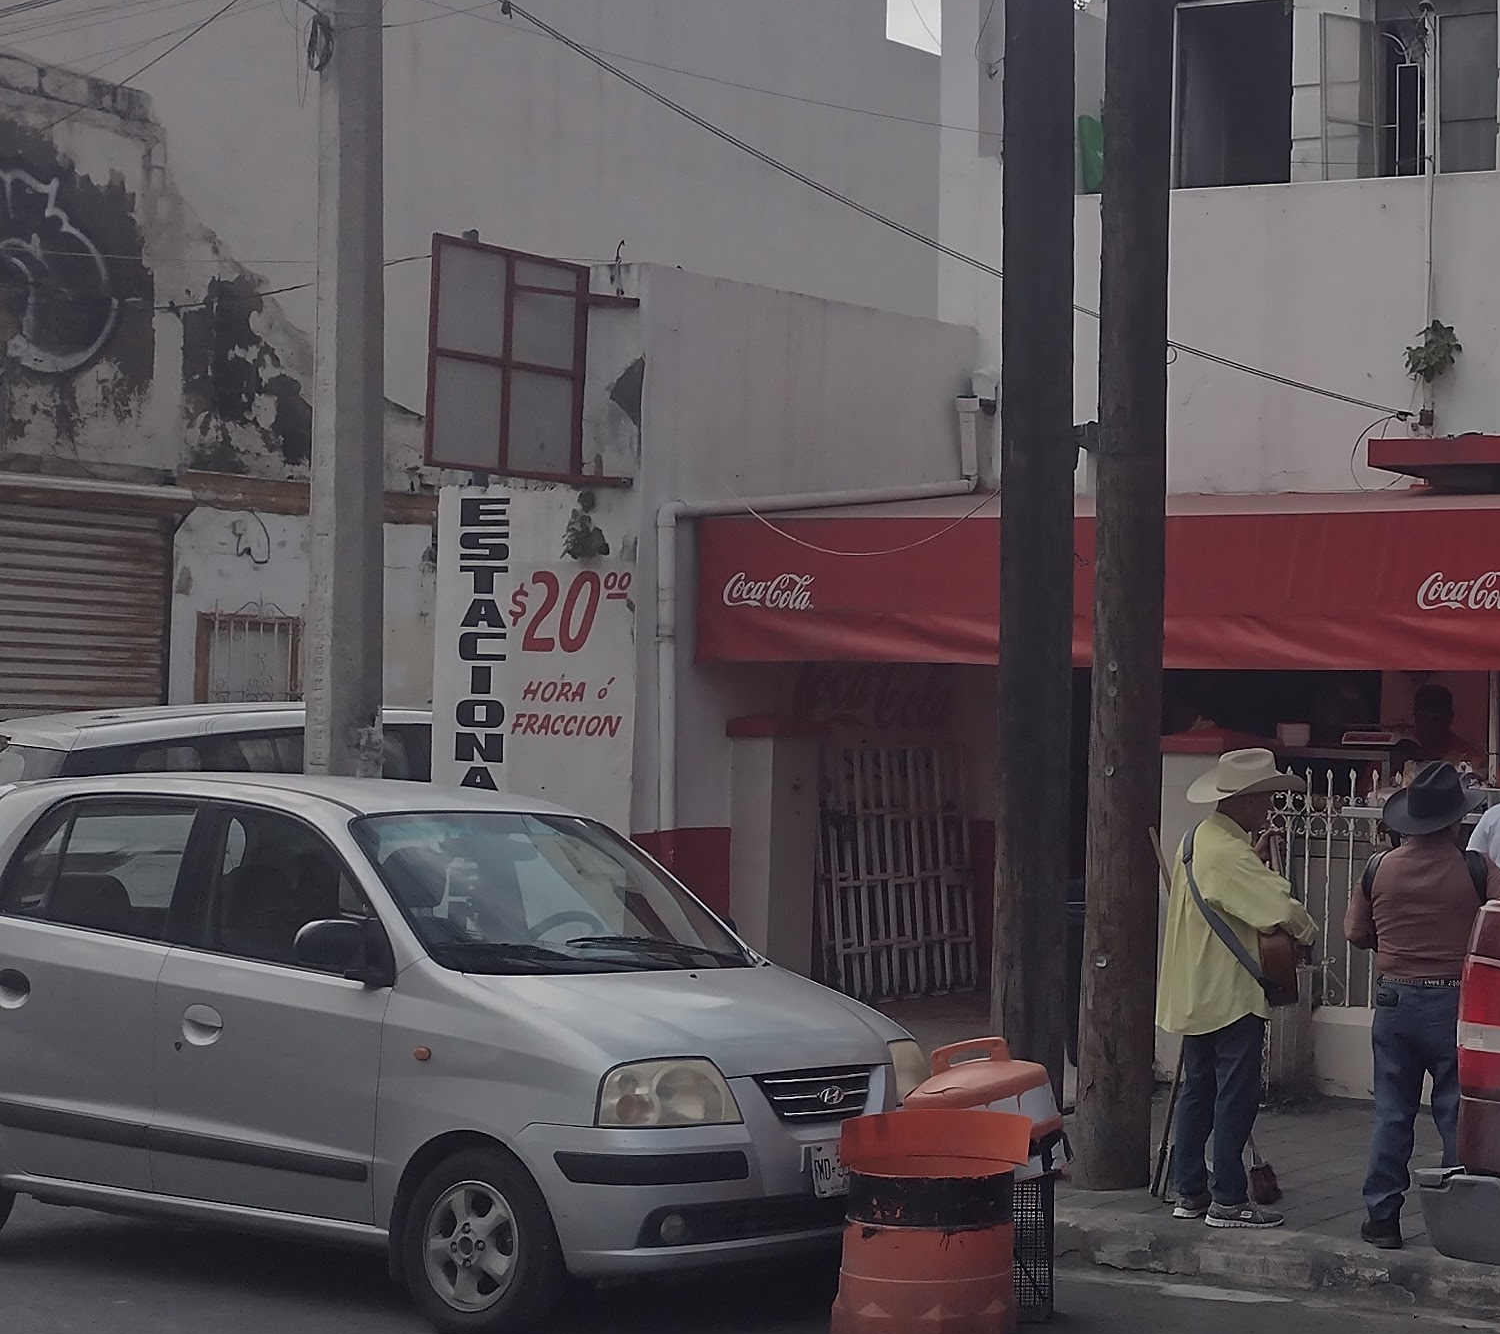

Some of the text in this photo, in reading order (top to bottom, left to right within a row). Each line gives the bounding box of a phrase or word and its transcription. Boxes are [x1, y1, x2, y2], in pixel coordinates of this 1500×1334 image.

[722, 572, 815, 610] Coca-Cola
[522, 680, 587, 703] HORA
[510, 713, 623, 738] FRACCION
